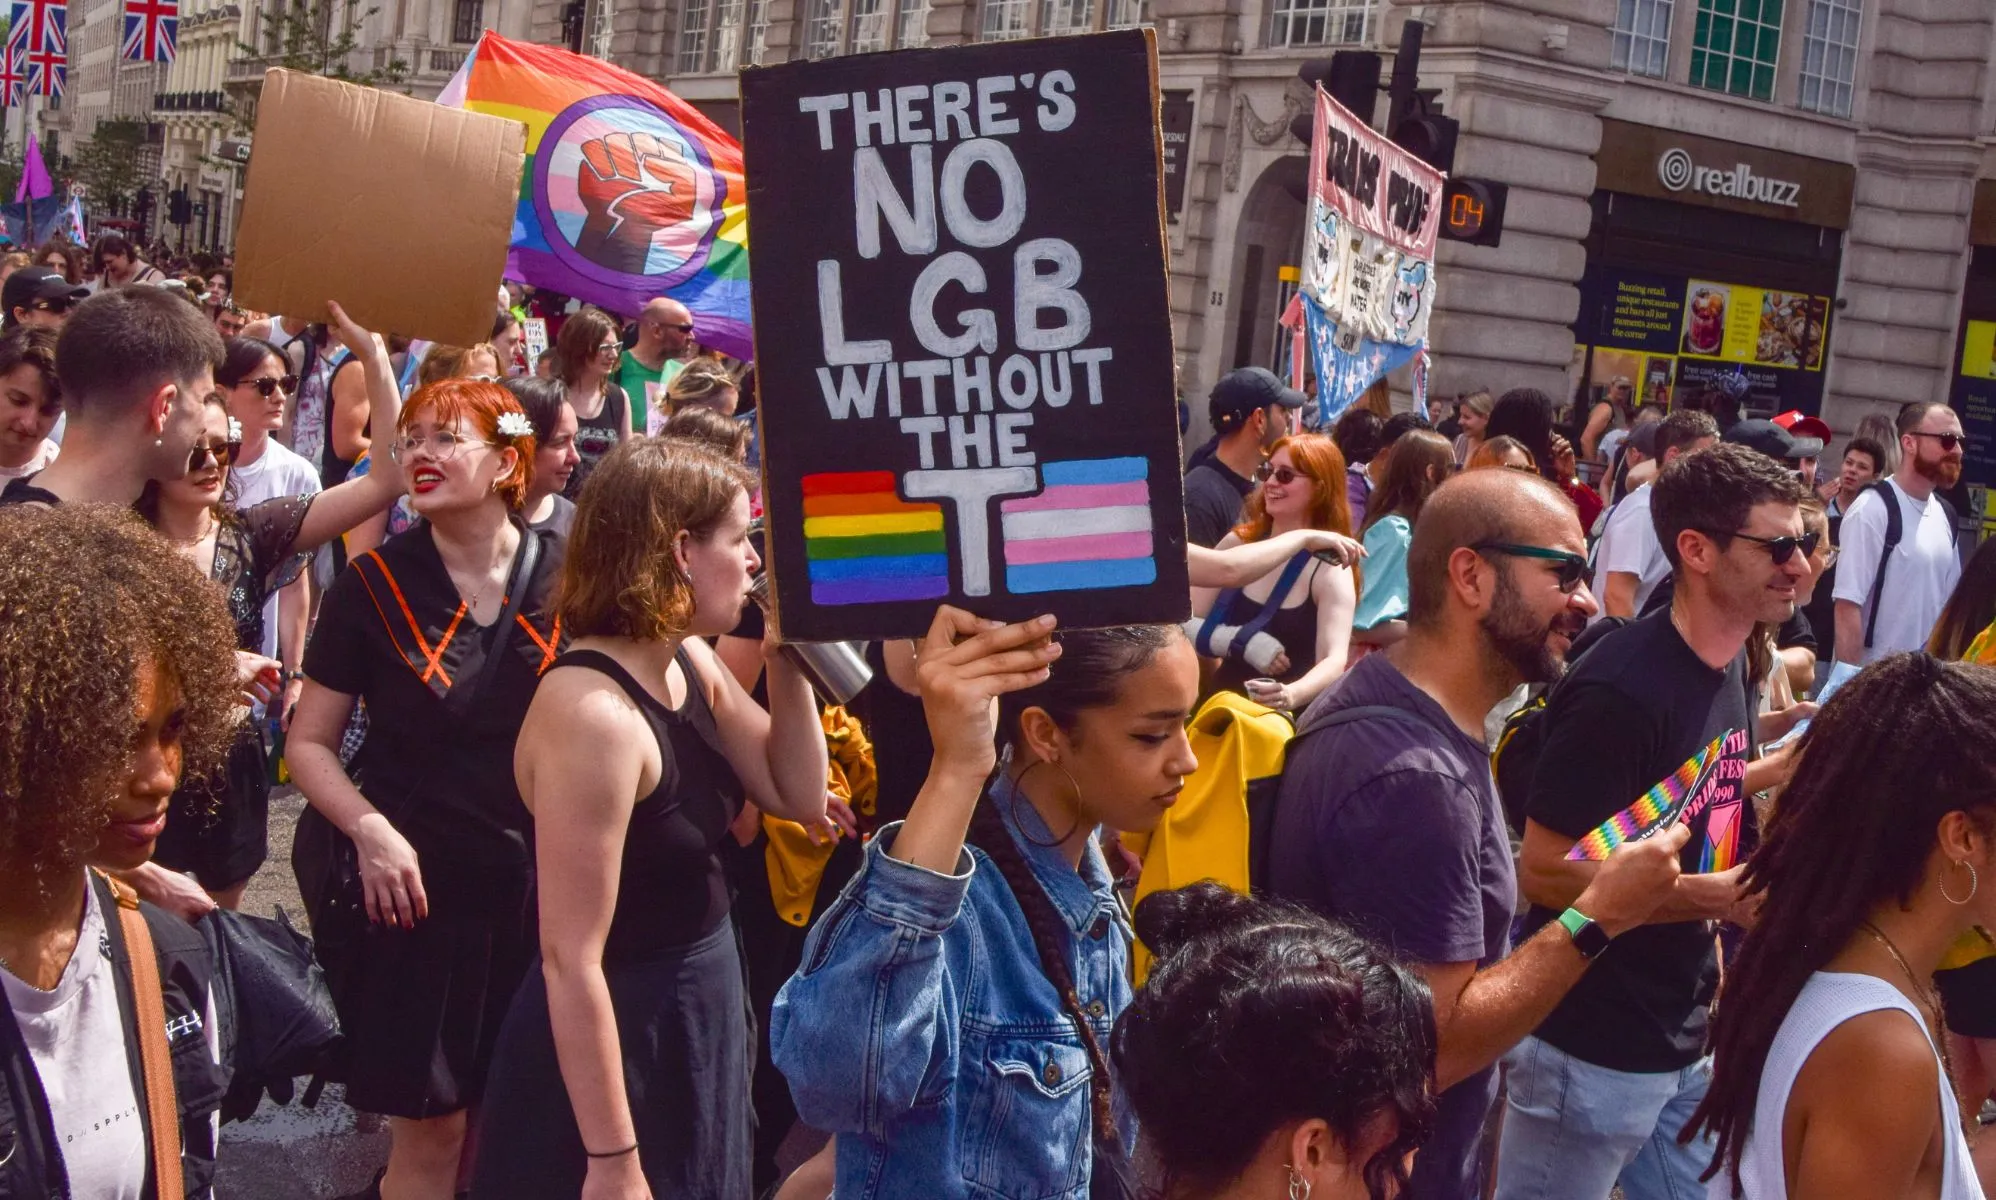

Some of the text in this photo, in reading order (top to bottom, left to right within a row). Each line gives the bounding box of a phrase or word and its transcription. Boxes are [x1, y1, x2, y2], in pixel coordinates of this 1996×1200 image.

[799, 69, 1077, 150] THERE'S
[1163, 132, 1187, 143] DESDALE
[1164, 148, 1176, 158] ANK
[1325, 124, 1381, 212] TRANS
[1693, 162, 1801, 208] realbuzz
[853, 137, 1028, 260] NO
[1450, 193, 1484, 228] 04
[816, 237, 1092, 367] LGB
[1615, 306, 1629, 315] and
[1612, 328, 1648, 340] the corner
[815, 346, 1114, 420] WITHOUT
[900, 412, 1037, 469] THE
[902, 465, 1038, 597] T
[1712, 784, 1735, 804] 990
